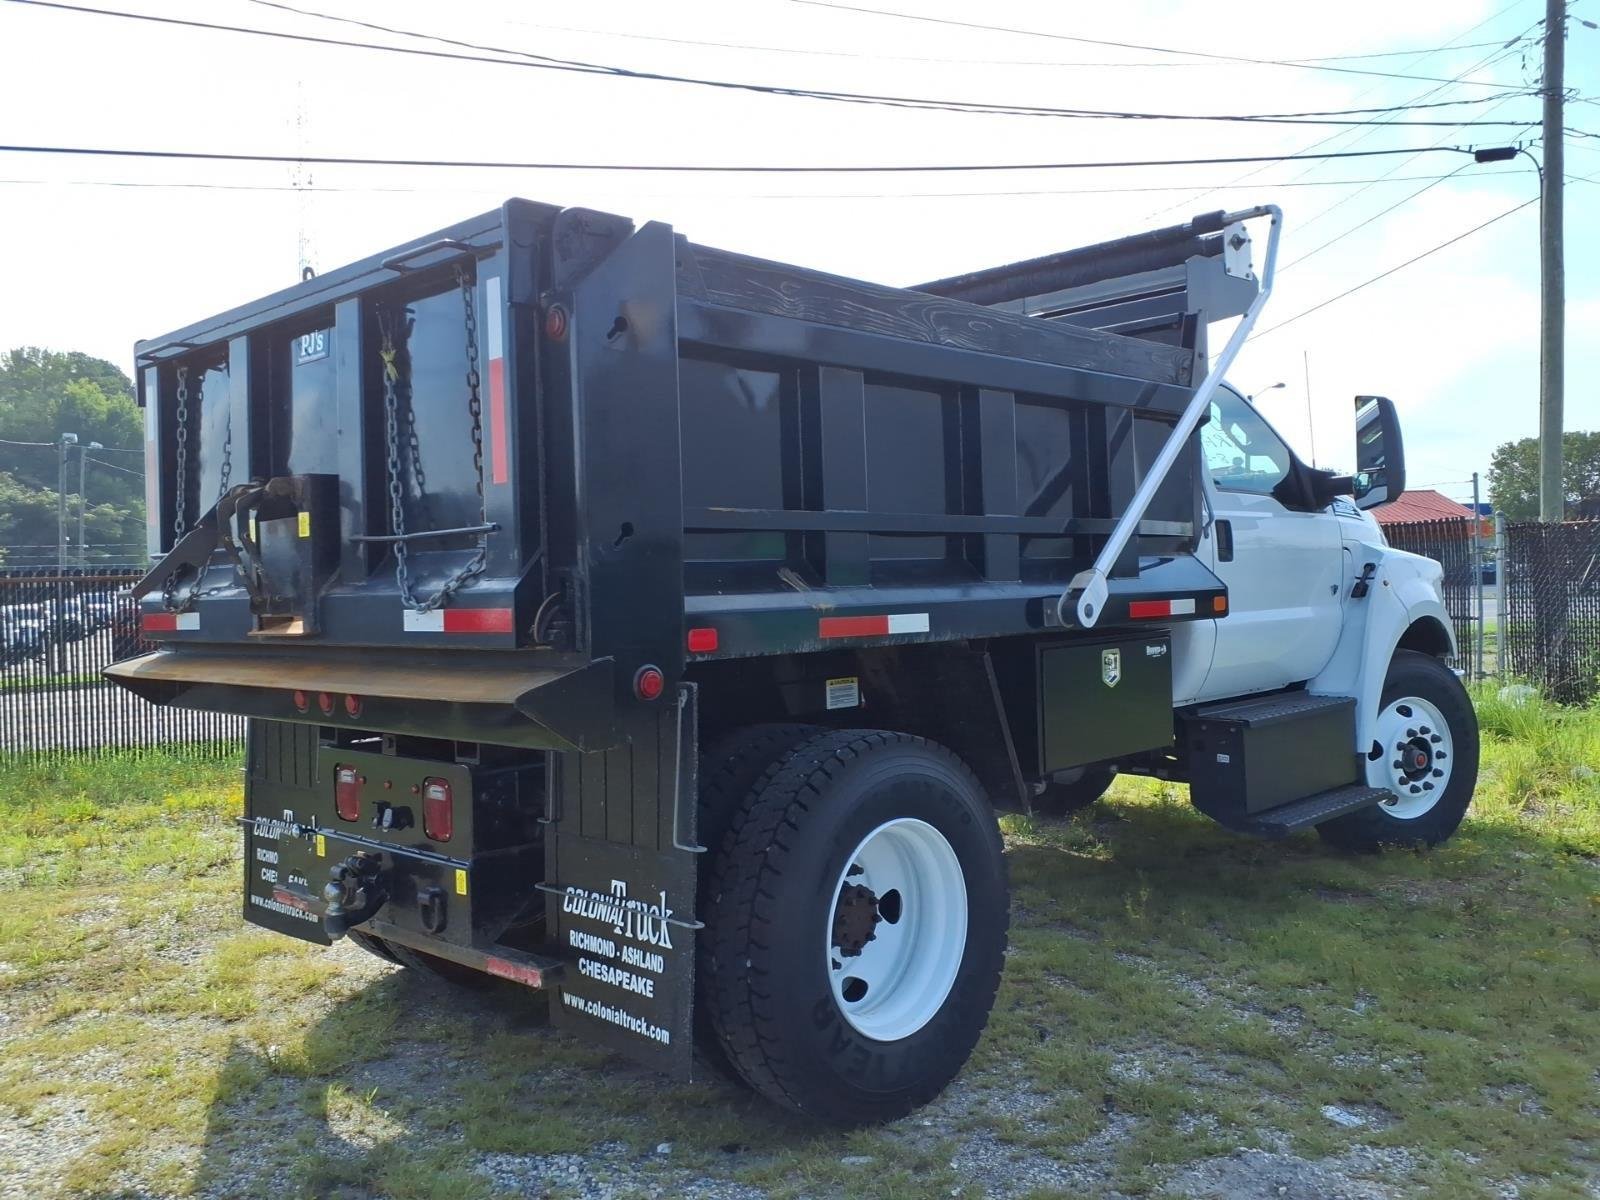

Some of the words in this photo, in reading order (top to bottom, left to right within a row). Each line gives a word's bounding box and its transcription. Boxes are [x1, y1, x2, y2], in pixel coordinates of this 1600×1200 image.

[301, 330, 323, 356] PJ's
[569, 929, 615, 958] RICHMOND
[621, 945, 664, 974] ASHLAND
[578, 957, 654, 998] CHESAPEAKE
[563, 991, 670, 1045] www.colonialtruck.com
